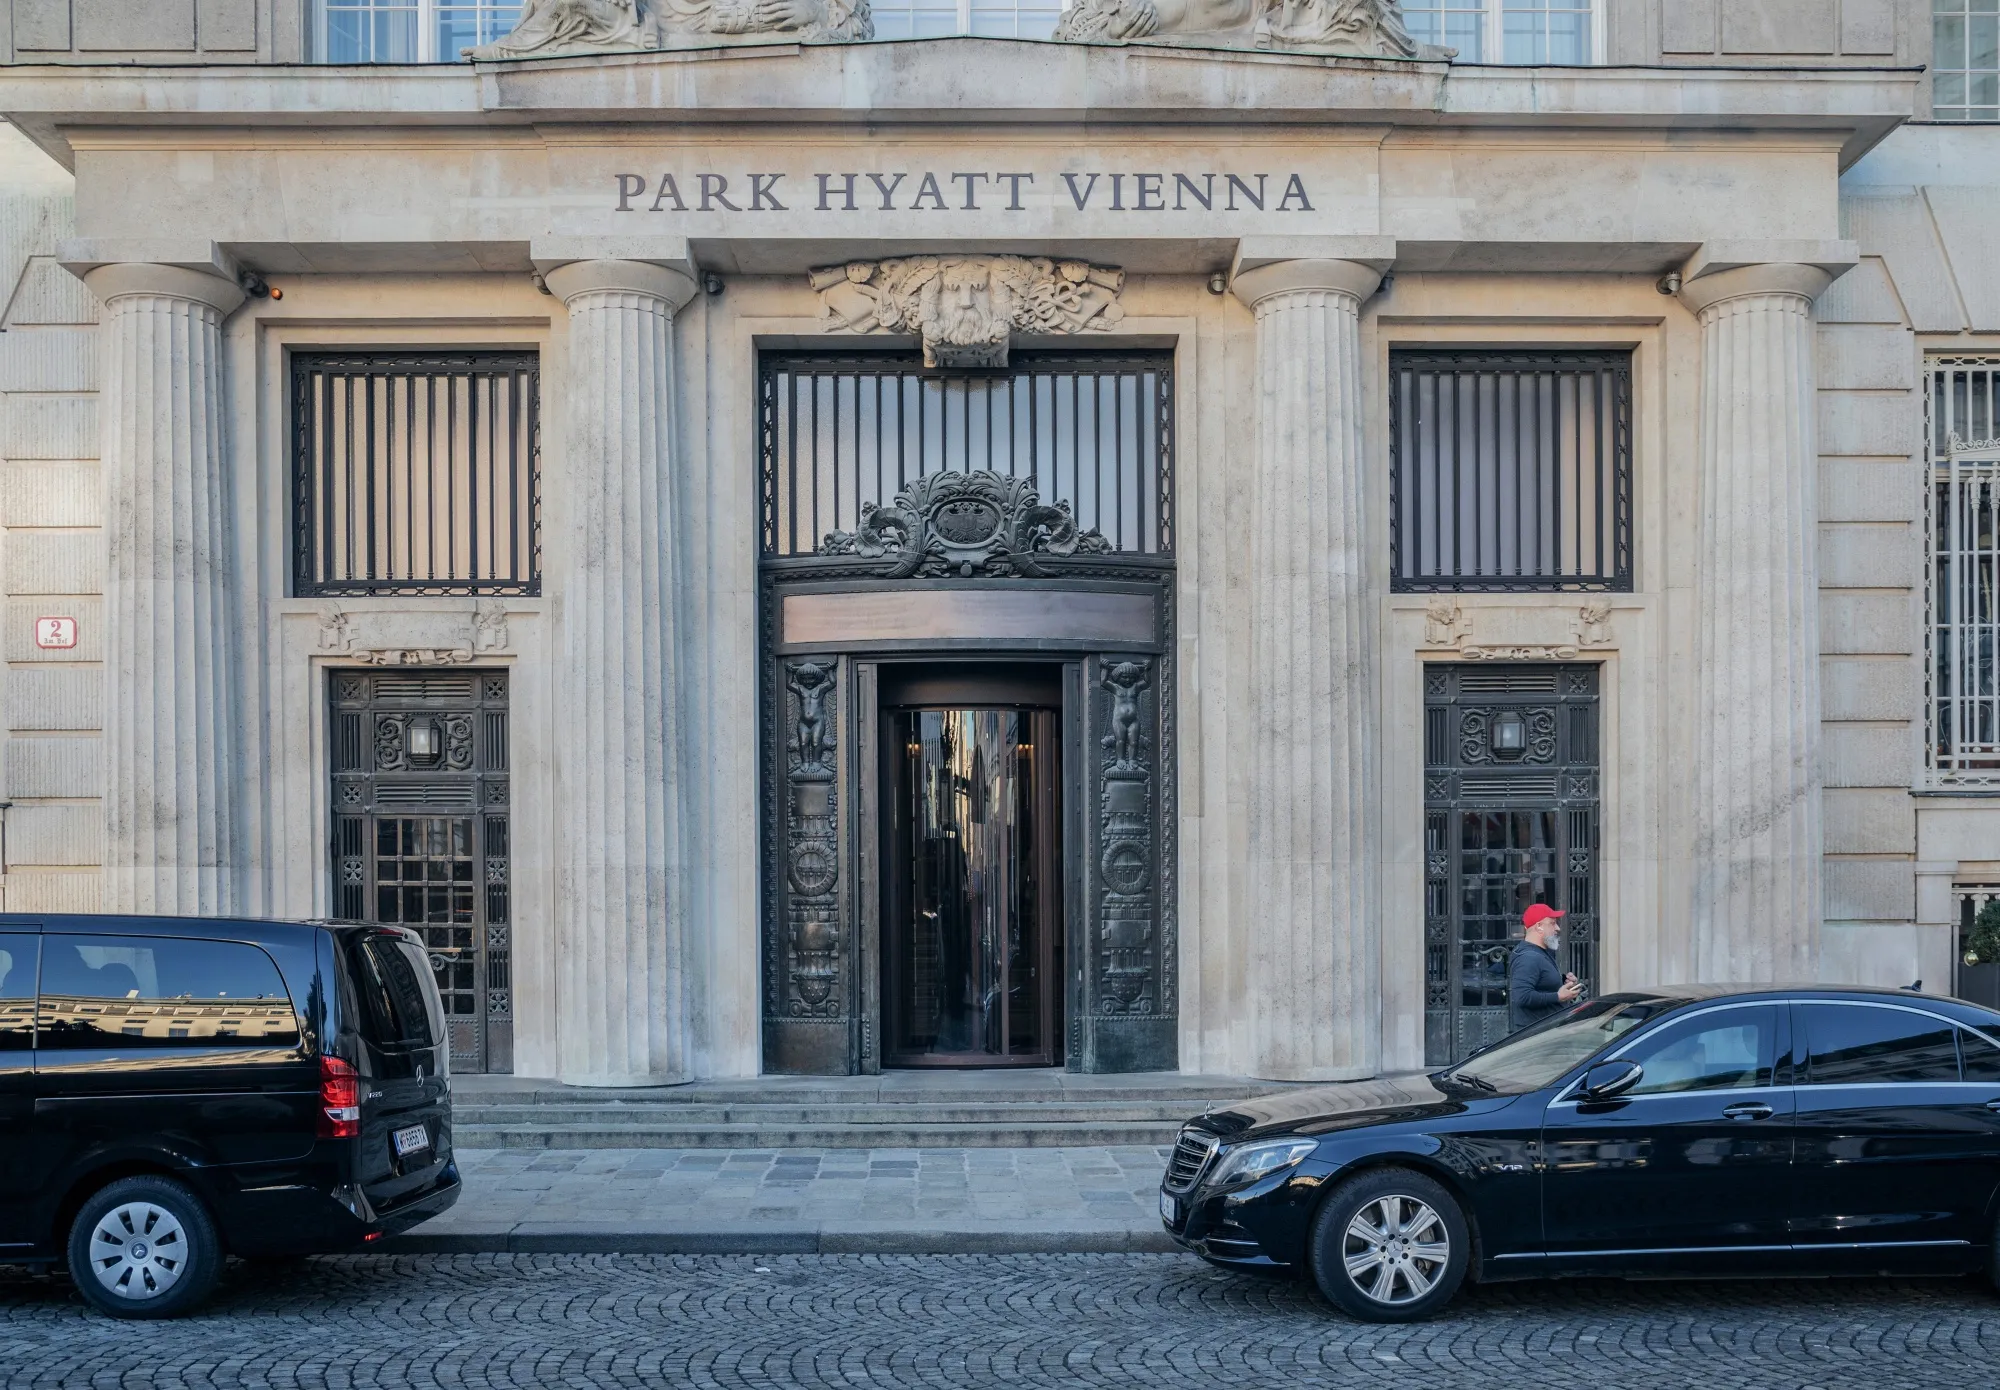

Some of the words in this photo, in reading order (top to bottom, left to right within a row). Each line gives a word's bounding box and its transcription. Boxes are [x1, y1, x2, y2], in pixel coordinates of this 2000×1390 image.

[614, 173, 789, 211] PARK
[813, 172, 1034, 210] HYATT
[1059, 172, 1315, 211] VIENNA
[51, 620, 61, 637] 2
